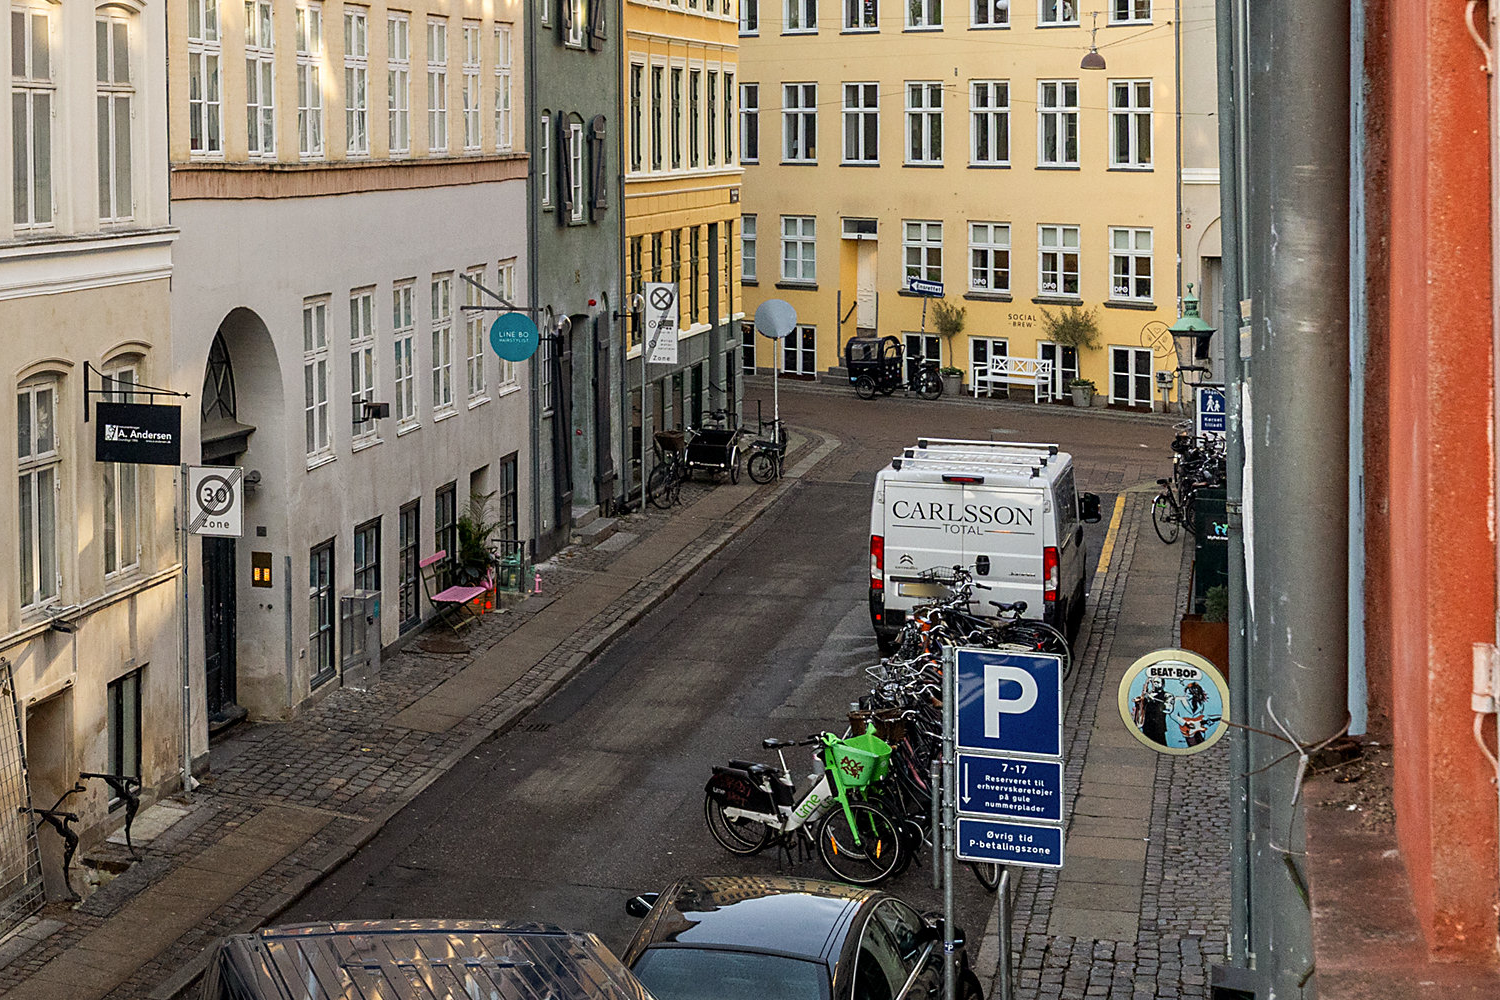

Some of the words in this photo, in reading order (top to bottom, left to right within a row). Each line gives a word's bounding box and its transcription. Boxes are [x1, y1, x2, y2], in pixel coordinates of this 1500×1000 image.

[916, 283, 941, 292] Ensrettet
[1008, 313, 1036, 321] SOCIAL
[118, 429, 128, 438] A.
[130, 429, 172, 440] Andersen
[204, 487, 227, 503] 30
[892, 500, 1034, 526] CARLSSON
[202, 518, 230, 529] Zone
[943, 523, 983, 536] TOTAL
[984, 664, 1038, 739] P
[1001, 763, 1027, 774] 7-17
[985, 774, 1031, 786] Reserveret
[977, 783, 1053, 796] erhvervskøretøjer
[1012, 795, 1031, 803] gule
[795, 794, 821, 818] Lime
[985, 801, 1045, 812] nummerplader
[986, 830, 1013, 842] Øvrig
[1019, 834, 1033, 843] tid
